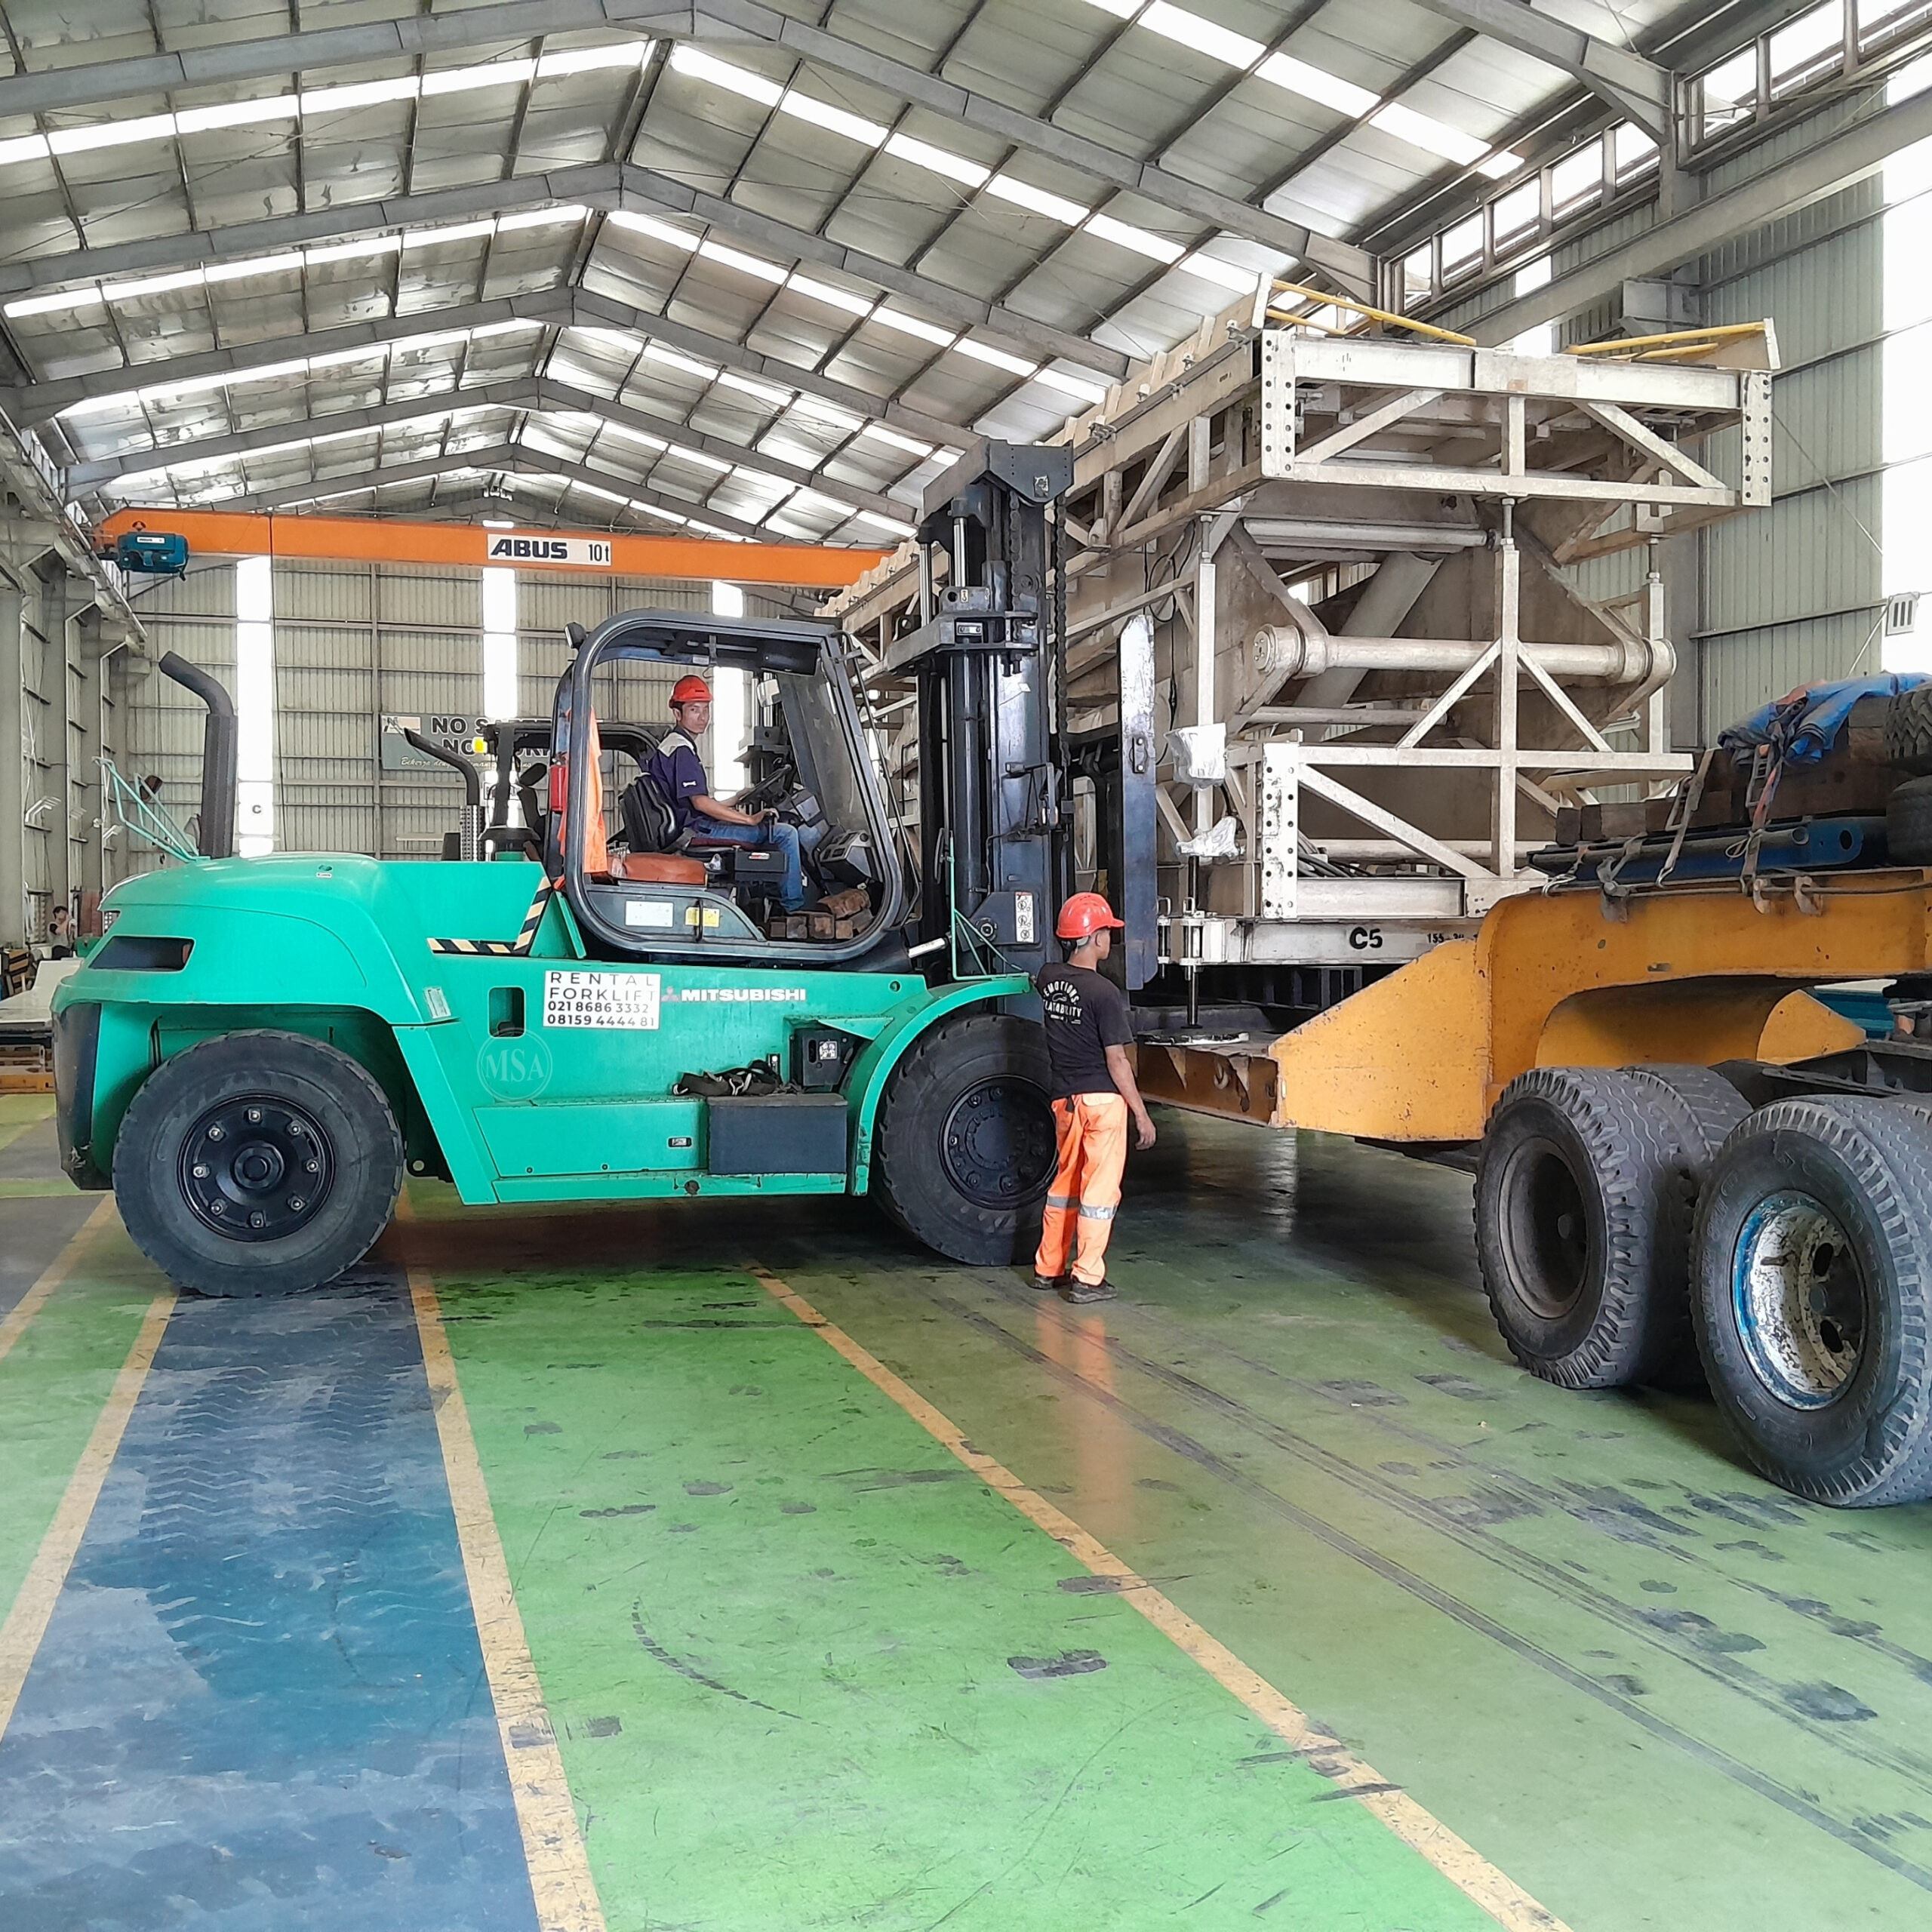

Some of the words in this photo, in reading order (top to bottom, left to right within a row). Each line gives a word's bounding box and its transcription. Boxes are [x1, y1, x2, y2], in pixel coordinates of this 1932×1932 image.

[491, 538, 568, 559] ABUS
[432, 716, 467, 734] NO
[252, 804, 262, 814] C
[1349, 927, 1383, 949] C5
[550, 971, 654, 986] RENTAL
[549, 987, 655, 1001] FORKLIFT
[681, 989, 807, 1002] MITSUBISHI
[1043, 980, 1080, 1004] EMOTIONS
[548, 1000, 571, 1011] 021
[575, 1001, 612, 1013] 8686
[615, 1003, 649, 1014] 3332
[547, 1014, 592, 1026] 08159
[595, 1015, 636, 1027] 4444
[640, 1017, 654, 1027] 81
[485, 1048, 545, 1082] MSA
